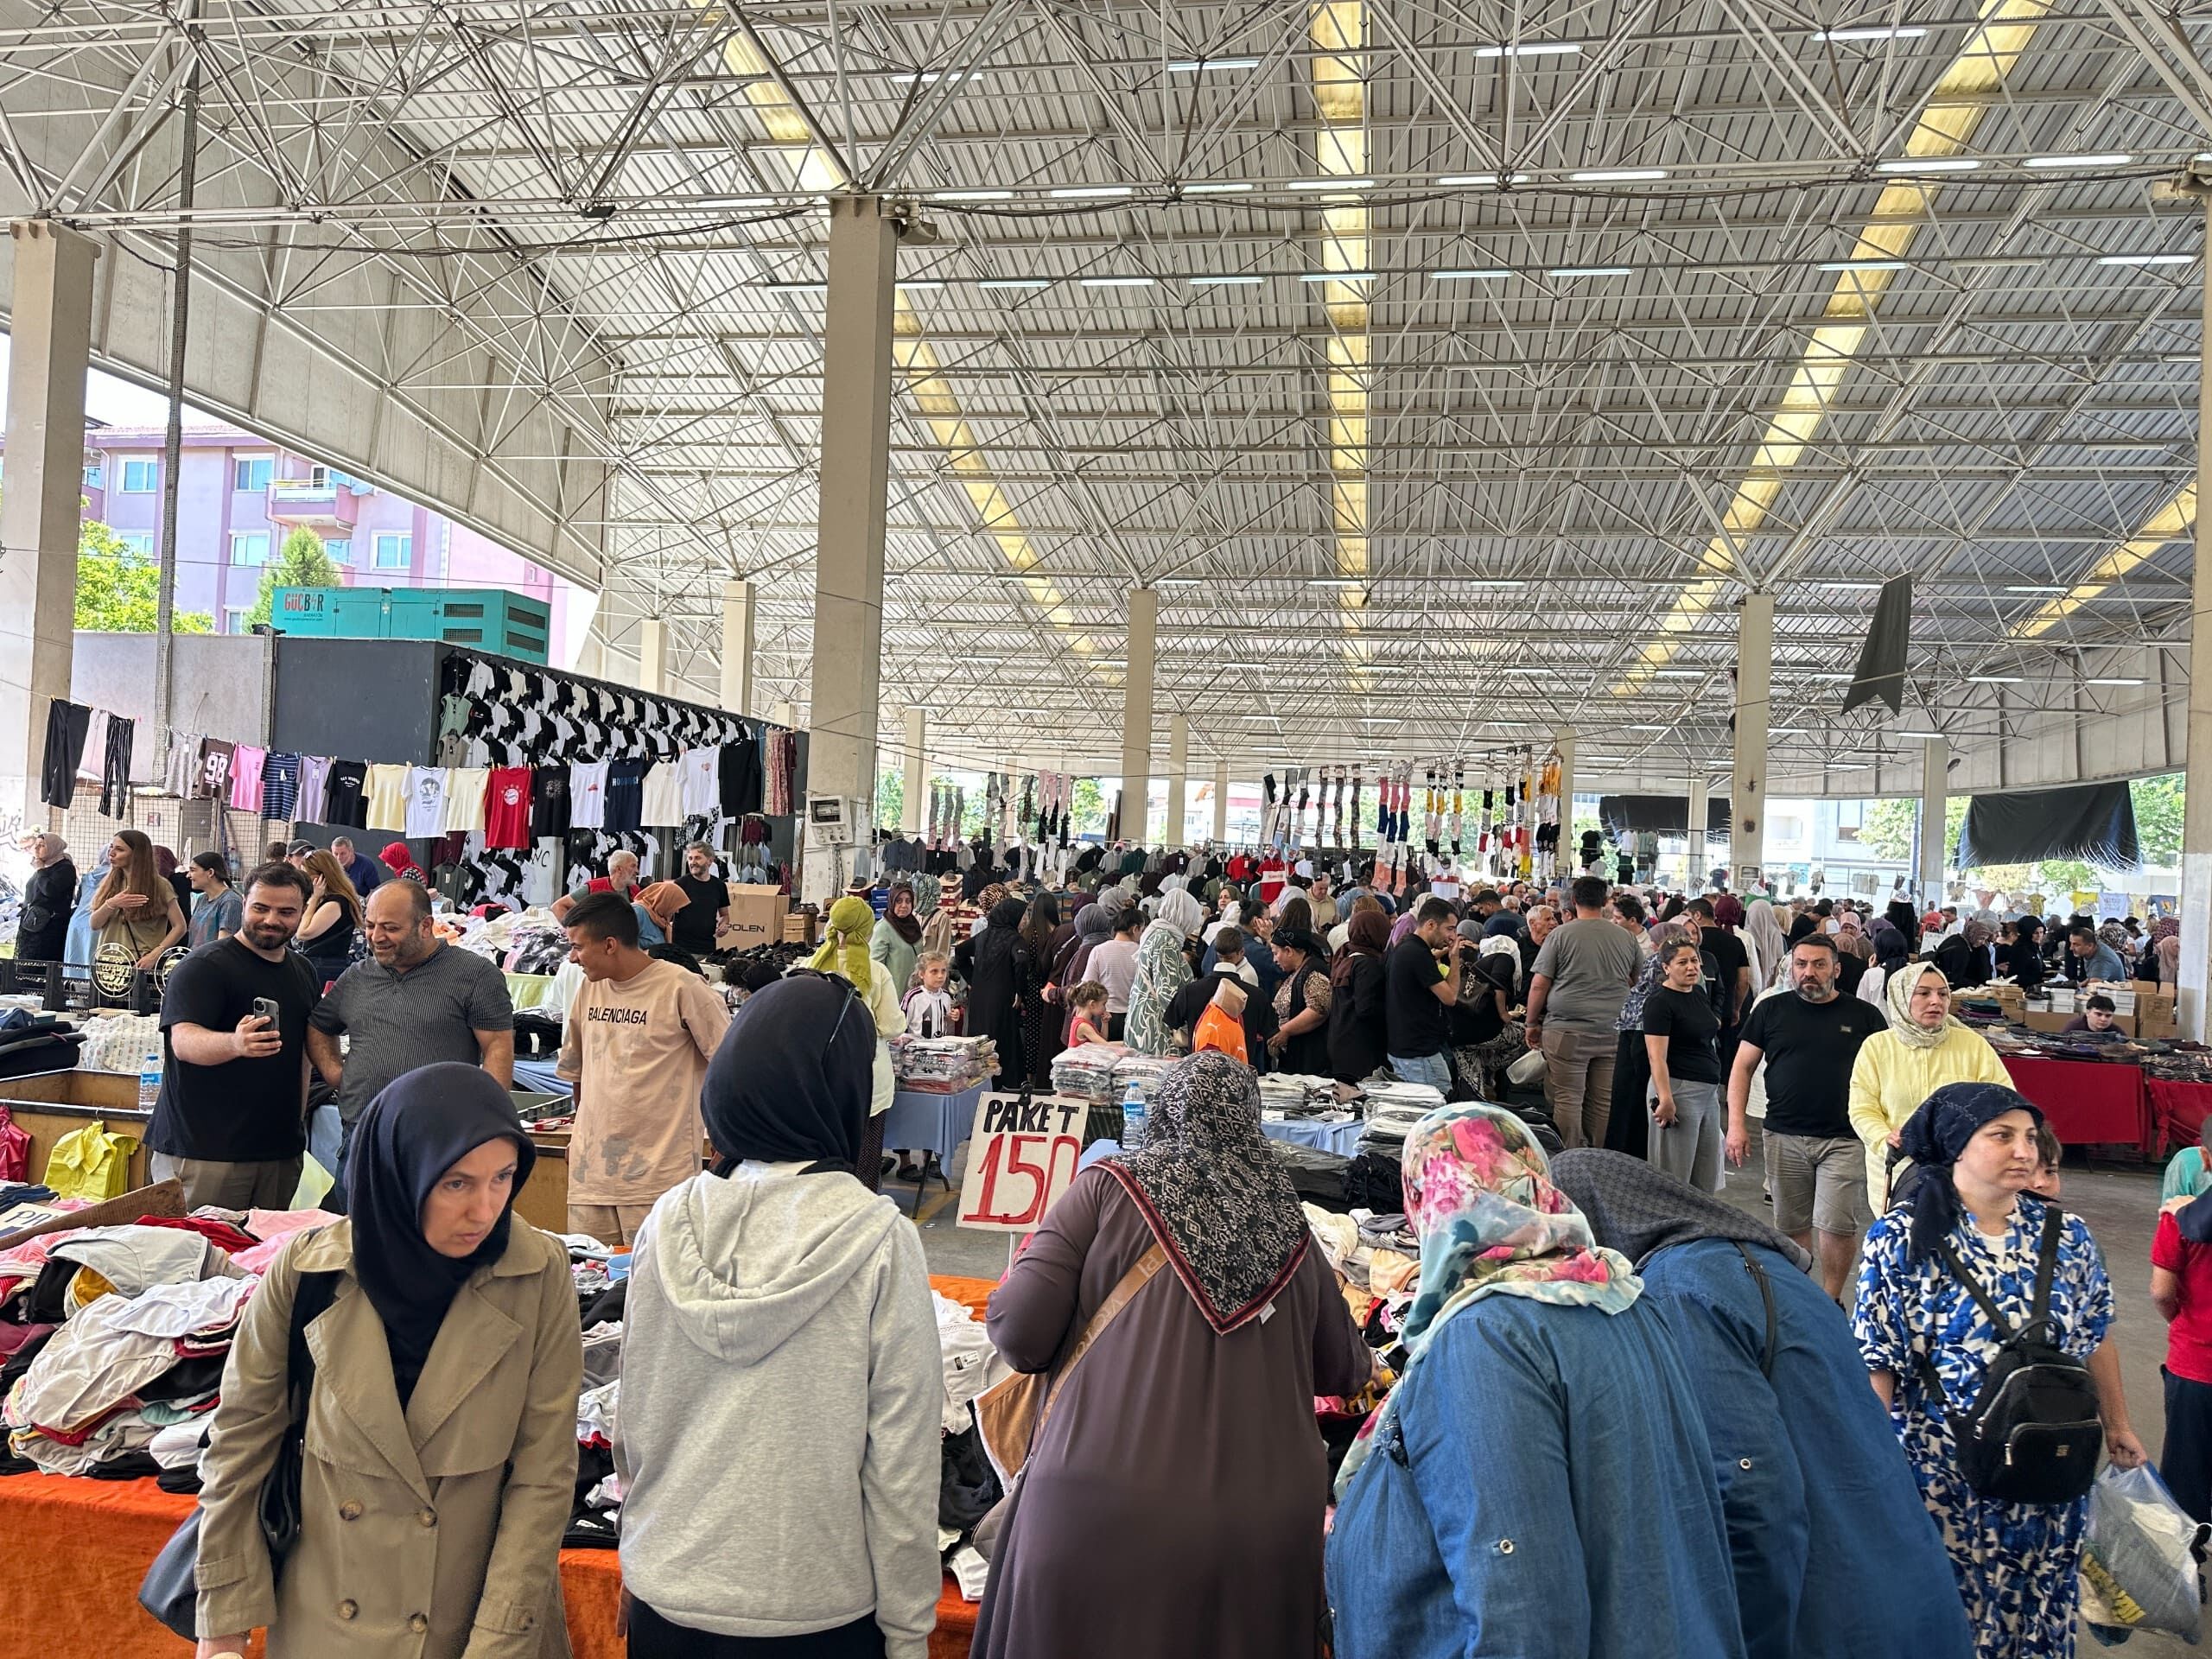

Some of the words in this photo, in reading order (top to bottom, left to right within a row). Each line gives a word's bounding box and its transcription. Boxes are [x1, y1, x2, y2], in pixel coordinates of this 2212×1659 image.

[204, 754, 228, 784] 98
[588, 1007, 647, 1026] BALENCIAGA
[982, 1099, 1080, 1134] PAKET
[962, 1133, 1081, 1225] 150
[3, 1210, 59, 1226] PA
